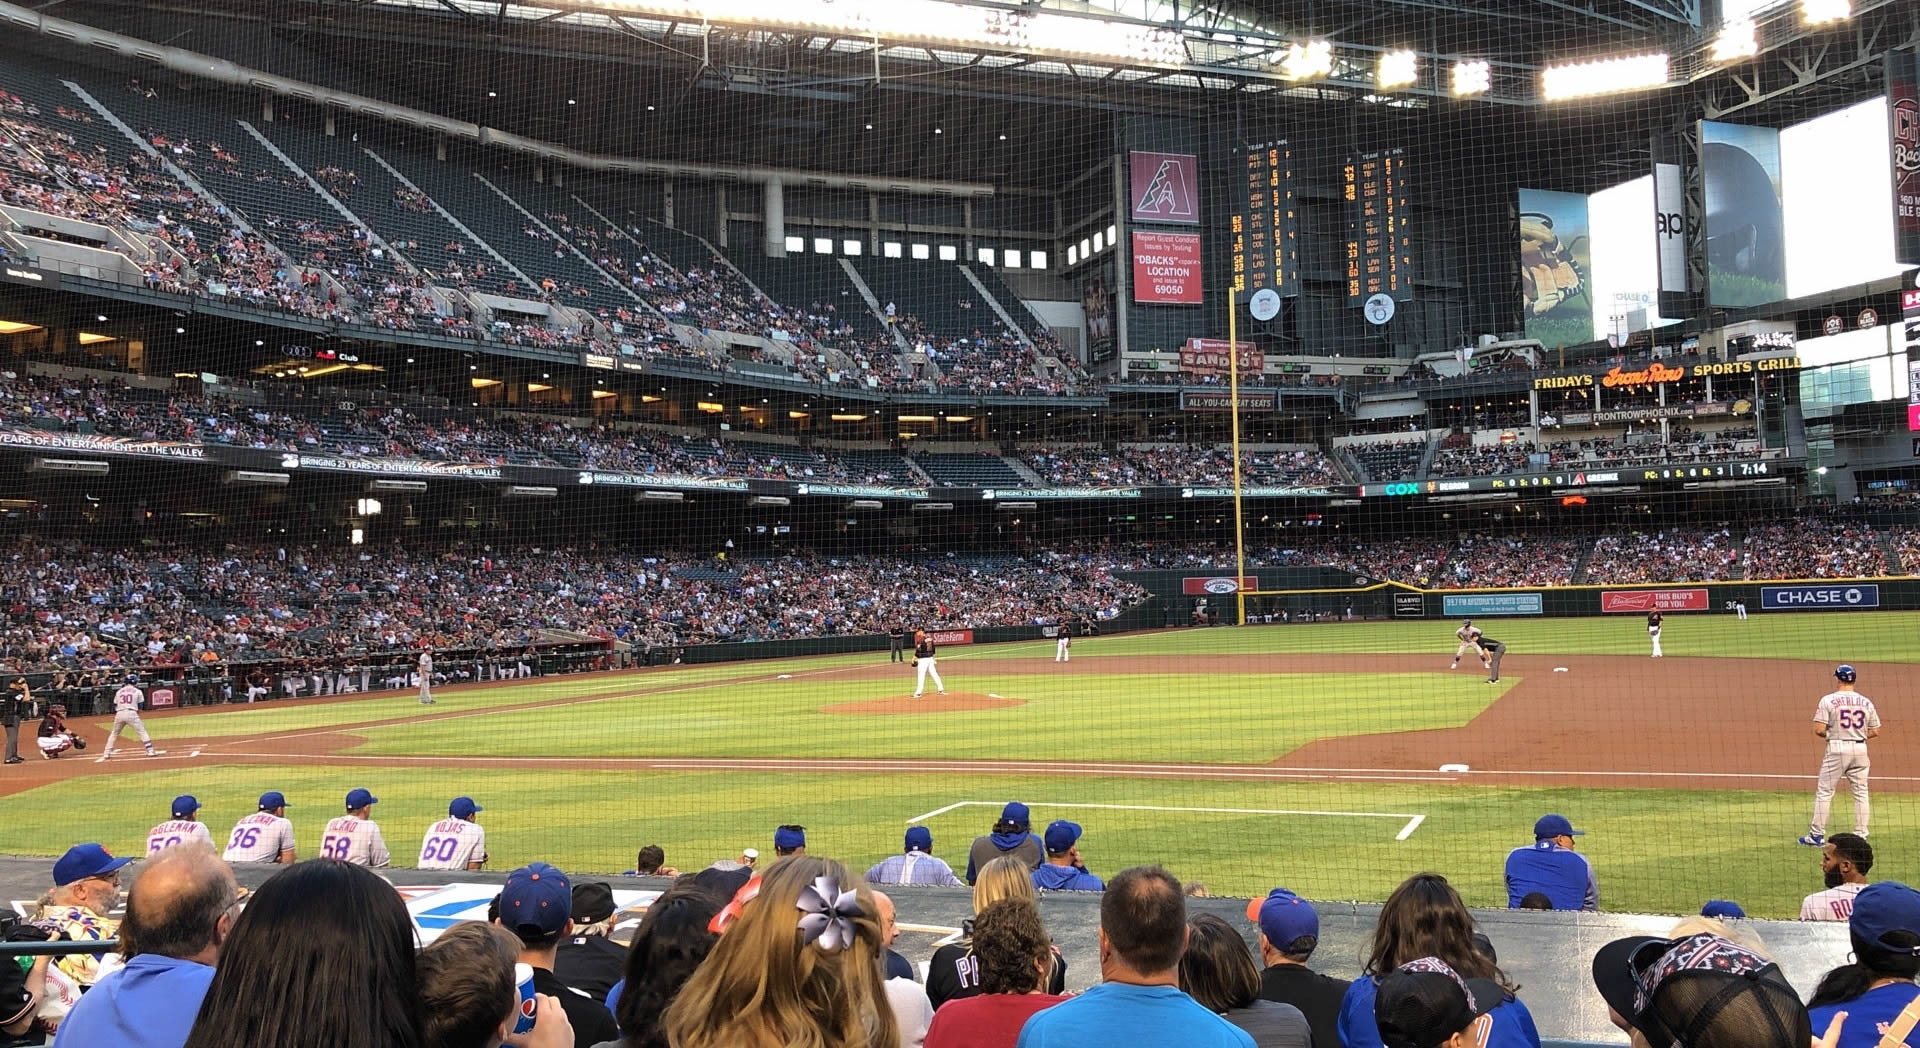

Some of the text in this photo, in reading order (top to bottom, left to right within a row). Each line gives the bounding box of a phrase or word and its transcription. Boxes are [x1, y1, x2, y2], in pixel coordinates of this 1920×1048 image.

[1147, 266, 1190, 277] LOCATION
[1154, 285, 1183, 294] 69050
[316, 350, 336, 359] Audi
[1183, 354, 1262, 367] SANDOT
[1534, 357, 1802, 389] FRIDAY'S Front Row SPORTS GRILL
[1251, 399, 1271, 407] SEATS
[1593, 407, 1694, 421] FRONTROWPHOENIX.com
[0, 434, 204, 458] YEARS OF ENTERTAINMENT TO THE VALLEY
[300, 457, 502, 478] BRINGING 25 YEARS OF ENTERTAINMENT TO THE VALLEY
[594, 474, 624, 483] BRINGING
[633, 476, 651, 484] YEARS
[662, 477, 708, 487] ENTERTAINMENT
[1385, 482, 1418, 496] COX
[1556, 476, 1562, 484] 0
[1645, 471, 1658, 479] PC:
[1703, 468, 1711, 476] B:
[1740, 463, 1768, 476] 7:14
[1777, 590, 1841, 604] CHASE
[119, 694, 132, 704] 30
[1830, 693, 1872, 709] SHERLOCK
[1839, 709, 1866, 730] 53
[228, 827, 261, 851] 36
[323, 836, 351, 861] 58
[423, 836, 458, 862] 60
